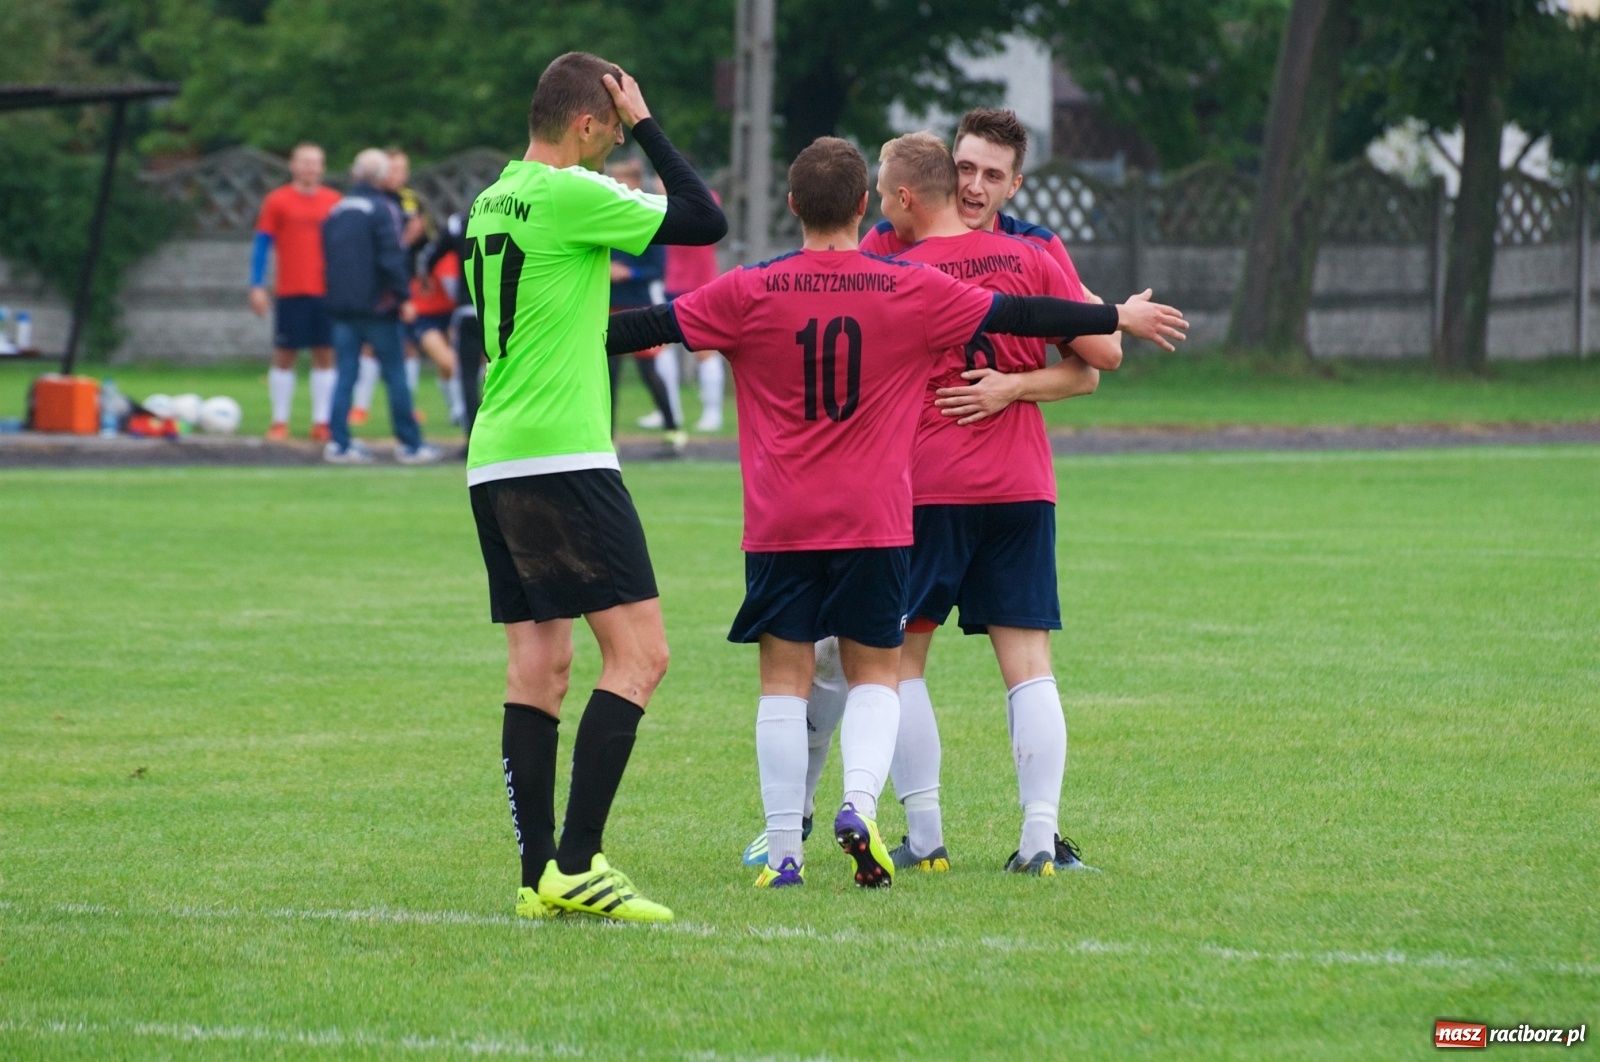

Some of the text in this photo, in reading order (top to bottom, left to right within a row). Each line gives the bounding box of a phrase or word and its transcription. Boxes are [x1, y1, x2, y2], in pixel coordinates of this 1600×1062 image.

[931, 254, 1023, 280] RZYŻANOWICE
[794, 271, 897, 293] KRZYŻANOWICE
[795, 315, 862, 422] 10
